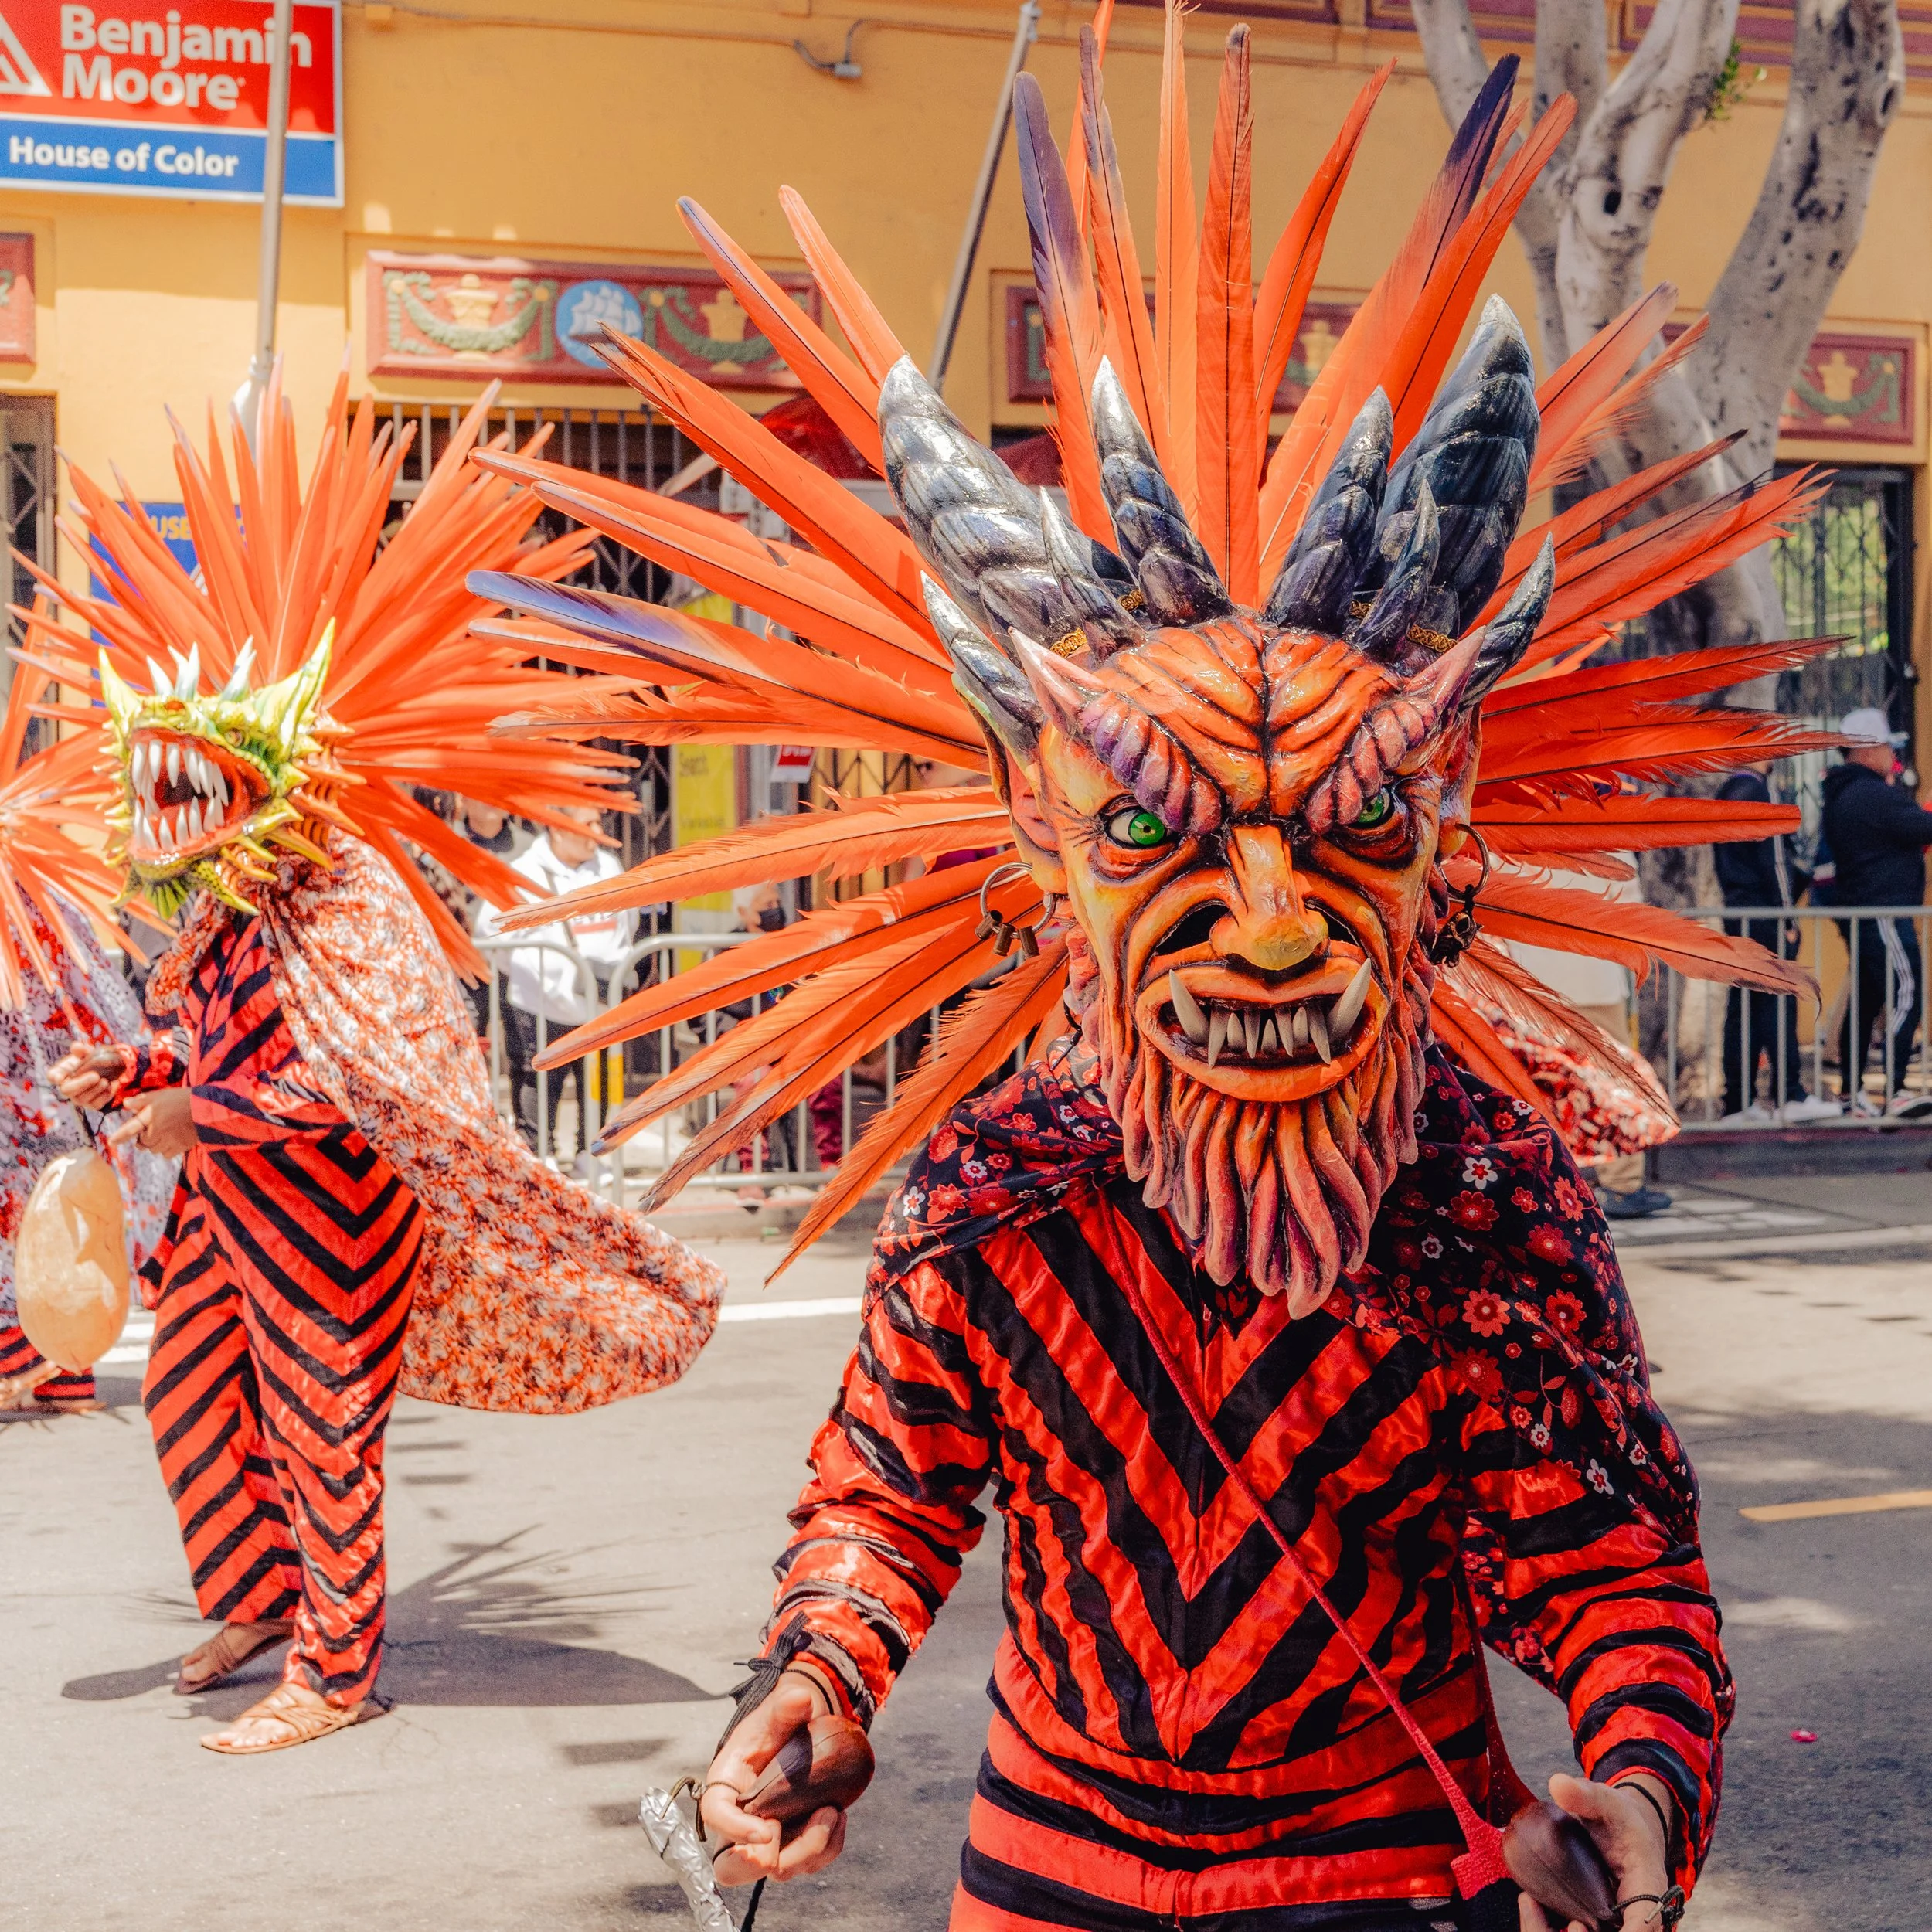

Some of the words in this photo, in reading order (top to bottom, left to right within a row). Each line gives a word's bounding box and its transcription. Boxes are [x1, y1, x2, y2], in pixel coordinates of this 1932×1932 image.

[60, 4, 312, 70] Benjamin
[61, 53, 240, 110] Moore
[9, 136, 110, 169] House
[115, 143, 150, 172] of
[155, 145, 239, 176] Color
